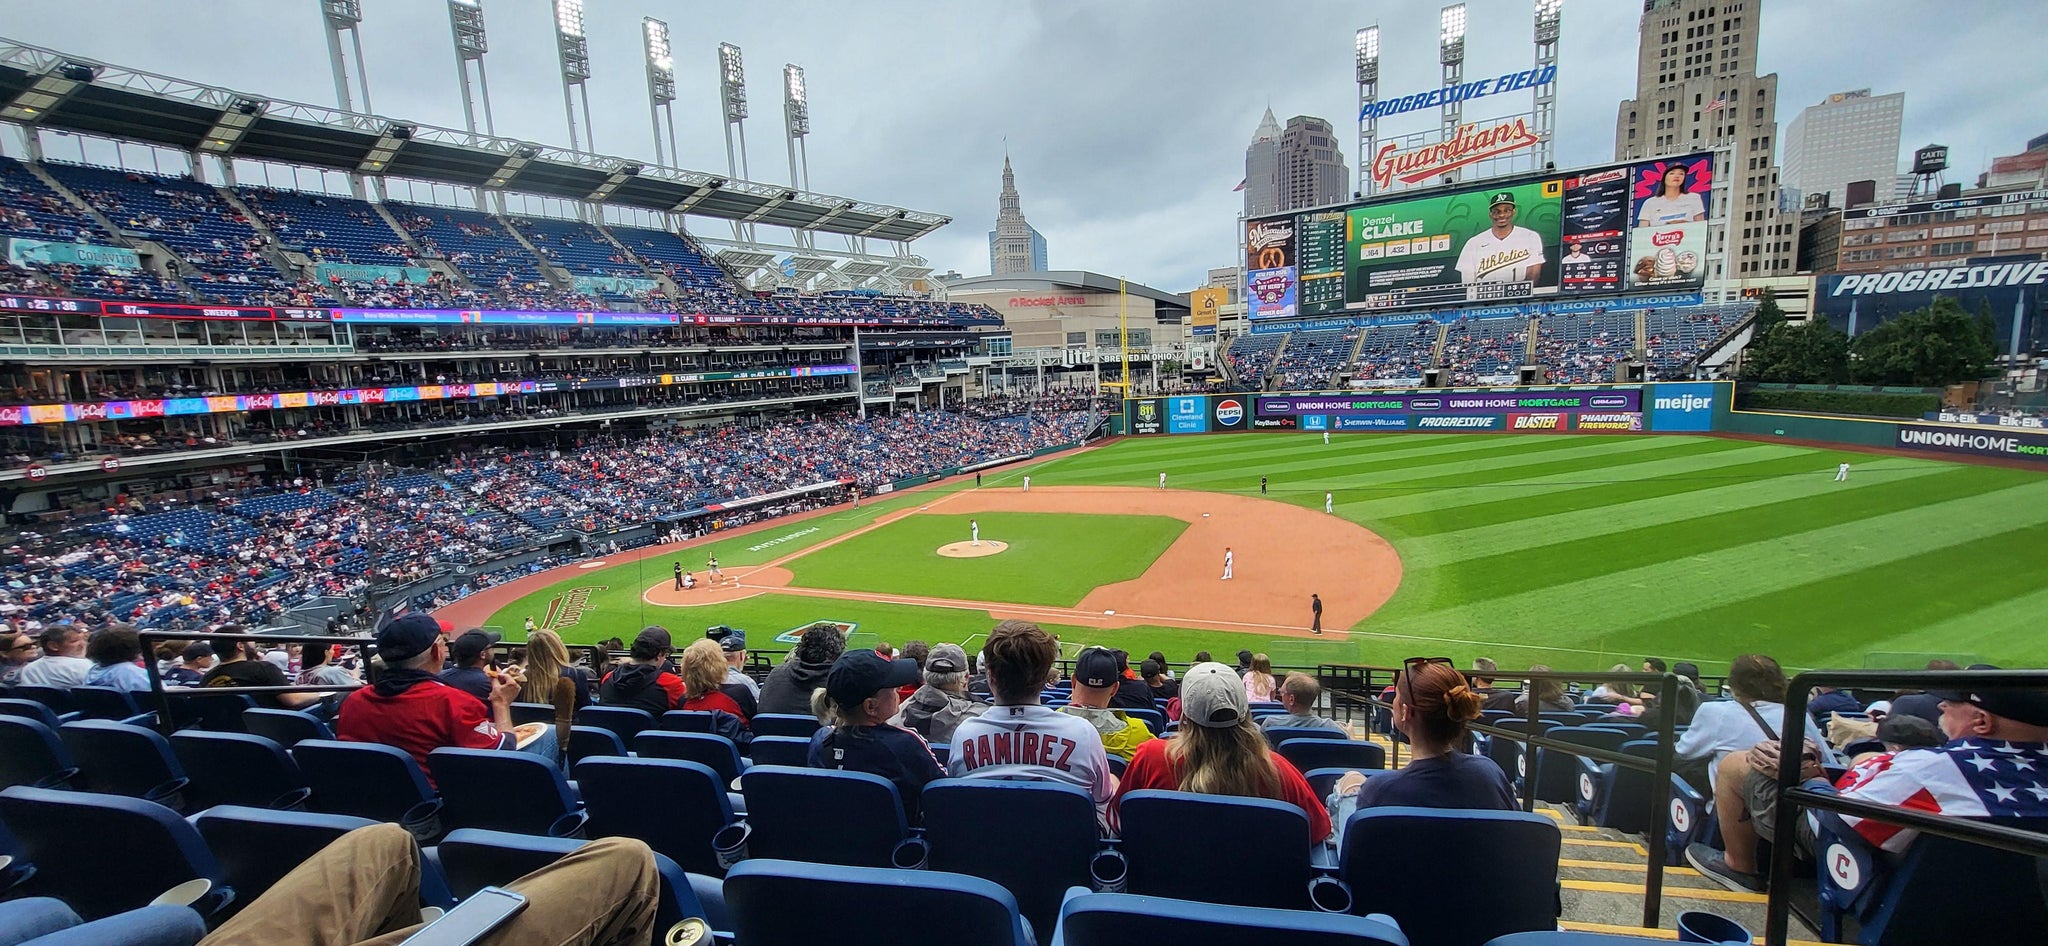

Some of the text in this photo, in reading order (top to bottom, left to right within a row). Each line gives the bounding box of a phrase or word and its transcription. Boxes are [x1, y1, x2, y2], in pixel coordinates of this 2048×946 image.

[1358, 65, 1557, 122] PROGRESSIVE FIELD
[1845, 89, 1868, 100] PNC
[1372, 117, 1540, 191] Guardians
[1363, 213, 1395, 227] Denzel
[1362, 219, 1424, 240] CLARKE
[77, 249, 134, 265] COLAVITO
[1477, 248, 1530, 273] Athletics
[1832, 262, 2048, 297] PROGRESSIVE
[34, 299, 49, 310] 25
[62, 301, 77, 311] 36
[1020, 295, 1086, 307] Rocket Arena
[1561, 300, 1618, 310] HONDA
[1635, 294, 1695, 305] HONDA
[123, 305, 137, 315] 87
[203, 309, 240, 317] SWEEPER
[307, 311, 323, 319] 3-2
[1470, 306, 1521, 316] HONDA
[1388, 313, 1433, 322] HONDA
[1264, 322, 1301, 331] HONDA
[1315, 319, 1355, 328] HONDA
[1141, 353, 1150, 362] IN
[1152, 352, 1172, 361] OHIO
[1325, 401, 1351, 409] HOME
[1352, 401, 1403, 409] MORTGAGE
[1449, 400, 1483, 408] UNION
[1518, 398, 1581, 407] MORTGAGE
[1654, 394, 1712, 412] meijer
[1140, 405, 1153, 416] 811
[1172, 413, 1203, 421] Cleveland
[1418, 417, 1496, 427] PROGRESSIVE
[1514, 416, 1558, 429] BLASTER
[1580, 414, 1631, 422] PHANTOM
[104, 460, 118, 469] 25
[30, 468, 46, 478] 20
[962, 724, 1077, 772] RAMÍREZ
[1583, 779, 1590, 793] C
[1676, 805, 1684, 824] C
[1835, 853, 1850, 879] C
